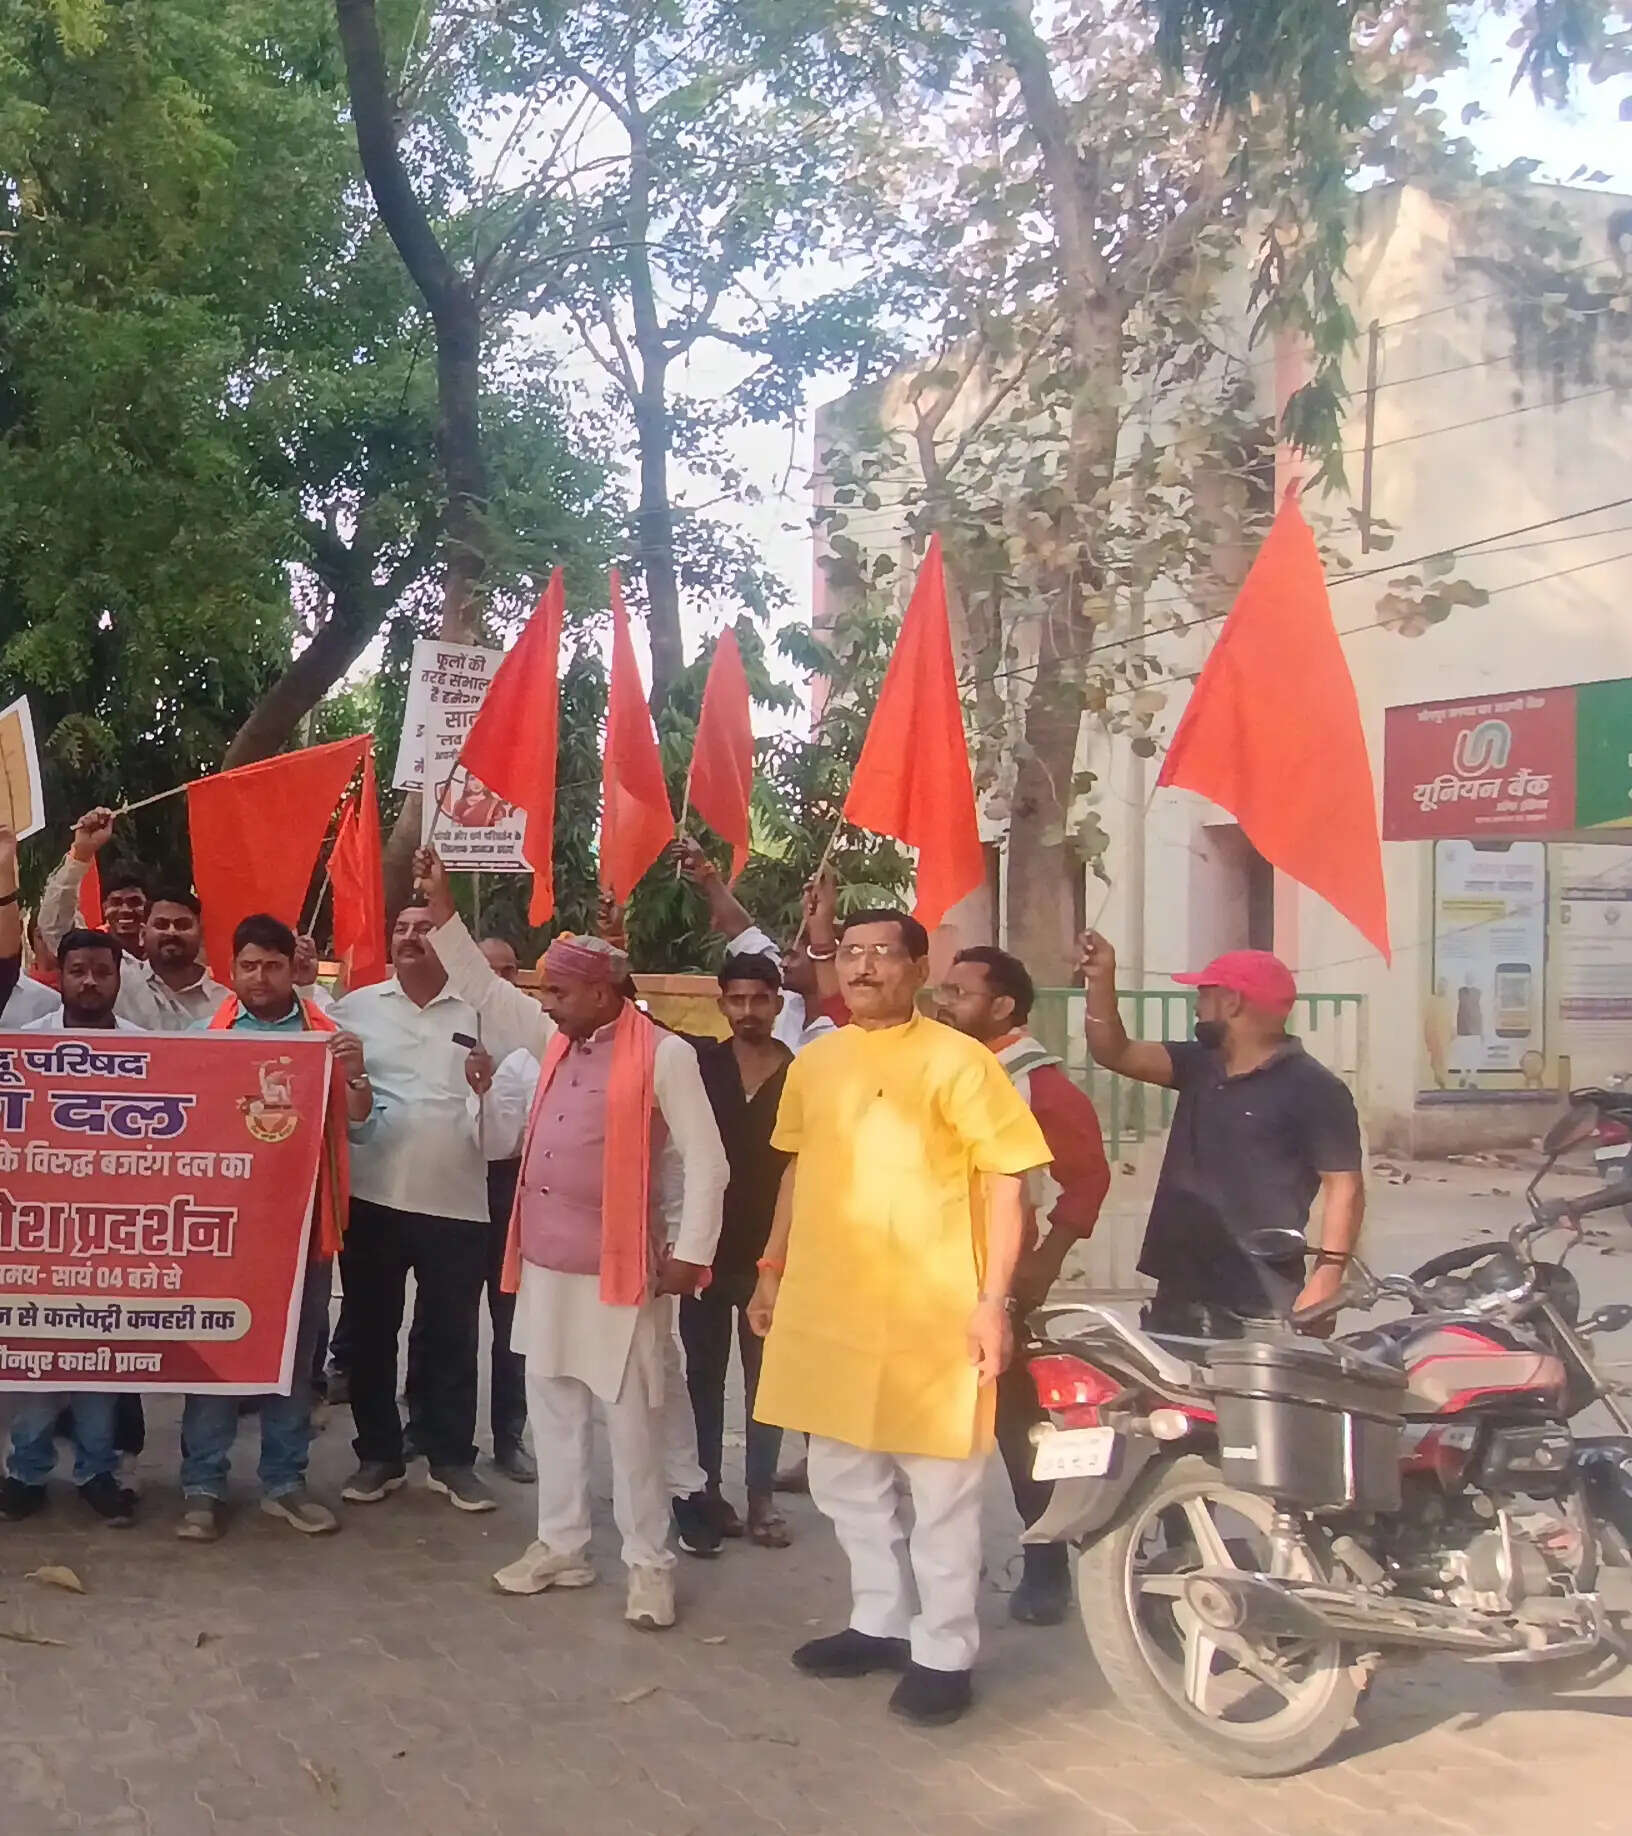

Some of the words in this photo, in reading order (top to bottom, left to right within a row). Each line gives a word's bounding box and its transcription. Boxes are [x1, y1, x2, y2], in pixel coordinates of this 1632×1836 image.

[421, 670, 447, 685] तरह
[468, 655, 487, 672] की
[431, 686, 439, 702] है
[1413, 775, 1503, 811] यूनियन
[1508, 768, 1552, 796] बैंक
[22, 1040, 150, 1079] परिषद
[48, 1090, 196, 1139] दल
[26, 1140, 96, 1177] विरुद्ध
[100, 1144, 172, 1177] बजरंग
[174, 1151, 217, 1177] दल
[219, 1153, 253, 1179] का
[70, 1194, 238, 1257] प्रदर्शन
[52, 1261, 93, 1287] सायं
[97, 1267, 122, 1288] 04
[127, 1263, 161, 1289] बजे
[162, 1263, 183, 1289] से
[18, 1302, 38, 1326] से
[44, 1303, 122, 1333] कलेक्ट्री
[127, 1304, 196, 1330] कचहरी
[200, 1311, 235, 1330] तक
[57, 1347, 111, 1371] काशी
[114, 1352, 162, 1373] प्रान्त
